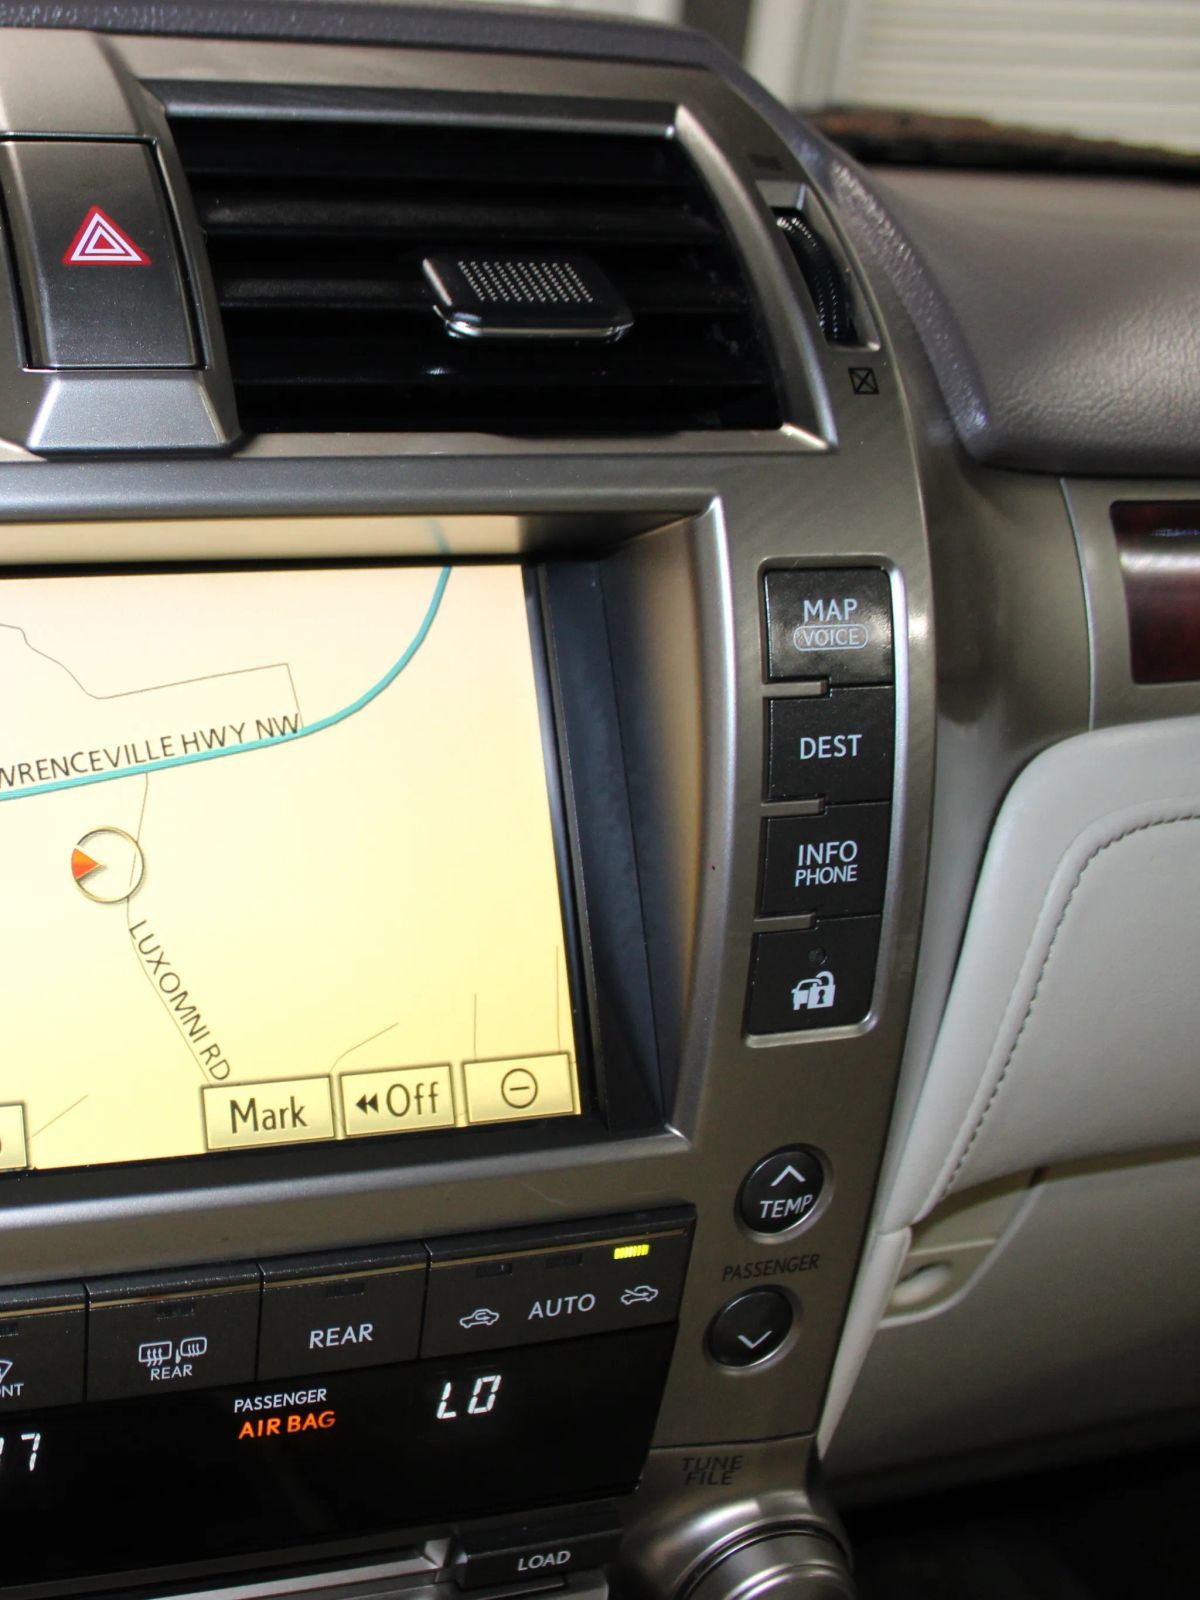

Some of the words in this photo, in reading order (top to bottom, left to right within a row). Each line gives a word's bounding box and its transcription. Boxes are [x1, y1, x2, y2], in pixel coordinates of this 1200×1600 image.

[803, 598, 858, 623] MAP
[801, 628, 860, 648] VOICE
[181, 722, 247, 755] HWY
[255, 713, 300, 741] NW
[799, 734, 863, 760] DEST
[798, 840, 858, 867] INFO
[794, 863, 858, 888] PHONE
[127, 919, 213, 1045] LUXOMNI
[199, 1042, 232, 1083] RD
[385, 1081, 440, 1118] Off
[229, 1096, 308, 1134] Mark
[759, 1194, 814, 1220] TEMP
[722, 1254, 822, 1282] PASSENGER
[528, 1293, 596, 1321] AUTO
[308, 1322, 374, 1350] REAR
[150, 1364, 193, 1381] REAR
[234, 1388, 328, 1413] PASSENGER
[238, 1416, 281, 1440] AIR
[287, 1410, 337, 1433] BAG
[681, 1454, 745, 1474] TUNE
[684, 1469, 736, 1487] FILE
[517, 1551, 571, 1573] LOAD
